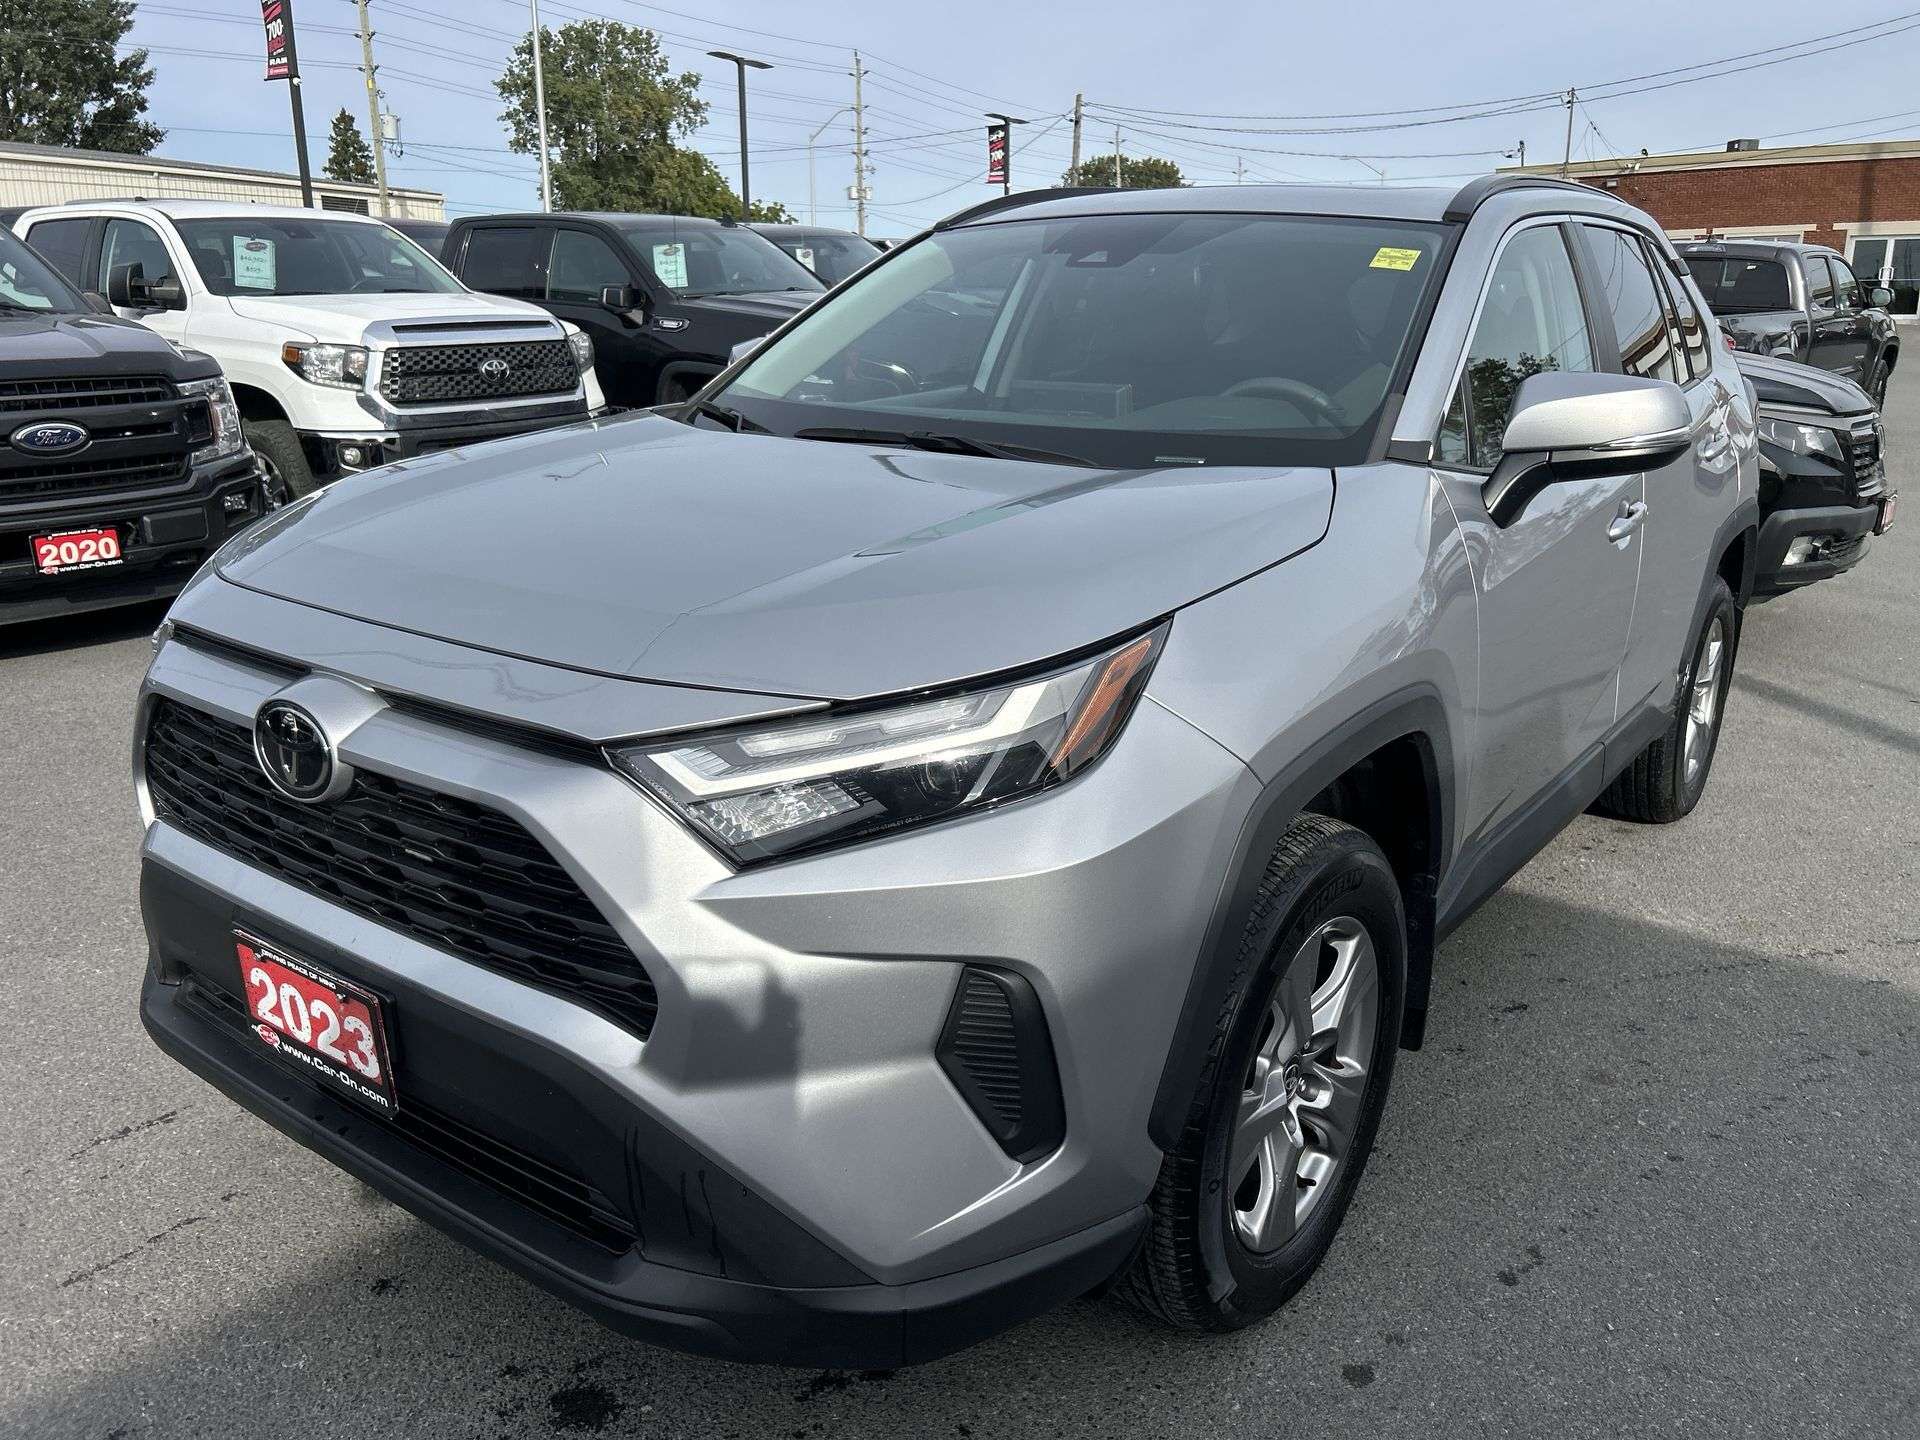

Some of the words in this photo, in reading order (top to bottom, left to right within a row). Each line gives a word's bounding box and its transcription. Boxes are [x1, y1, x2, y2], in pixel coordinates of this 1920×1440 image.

[269, 57, 287, 65] RAM
[34, 429, 73, 446] Ford
[40, 537, 117, 567] 2020
[59, 559, 123, 572] www.Car-On.com
[308, 971, 319, 980] OF
[250, 967, 381, 1079] 2023
[281, 1041, 389, 1108] www.Car-On.com
